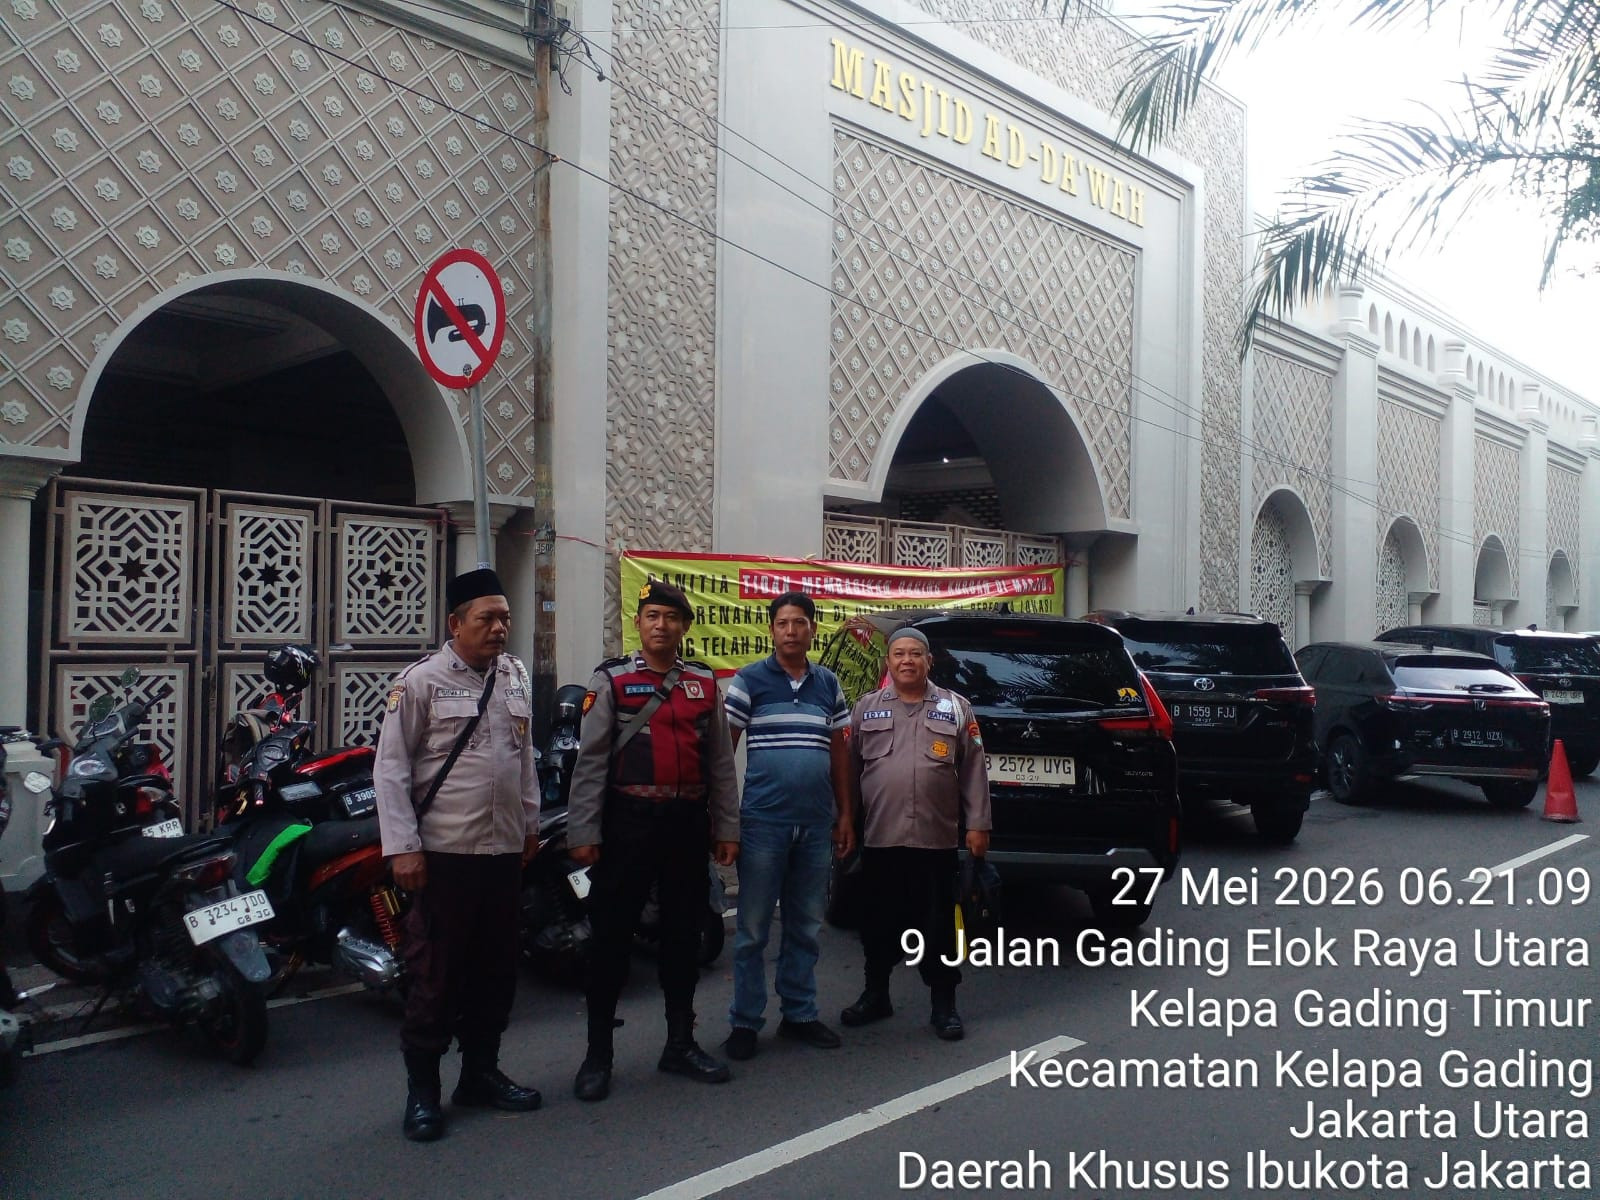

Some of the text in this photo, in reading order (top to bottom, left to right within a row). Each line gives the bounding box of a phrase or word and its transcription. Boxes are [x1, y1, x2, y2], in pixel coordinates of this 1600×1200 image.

[831, 38, 1146, 228] MASJID AD-DA'WAH
[742, 574, 791, 594] TIDAK
[702, 636, 750, 657] TELAH
[1173, 705, 1180, 717] B
[1188, 706, 1211, 718] 1559
[999, 756, 1036, 773] 2572
[1043, 758, 1072, 775] UYG
[571, 875, 581, 886] B
[188, 915, 199, 928] B
[204, 901, 238, 923] 3234
